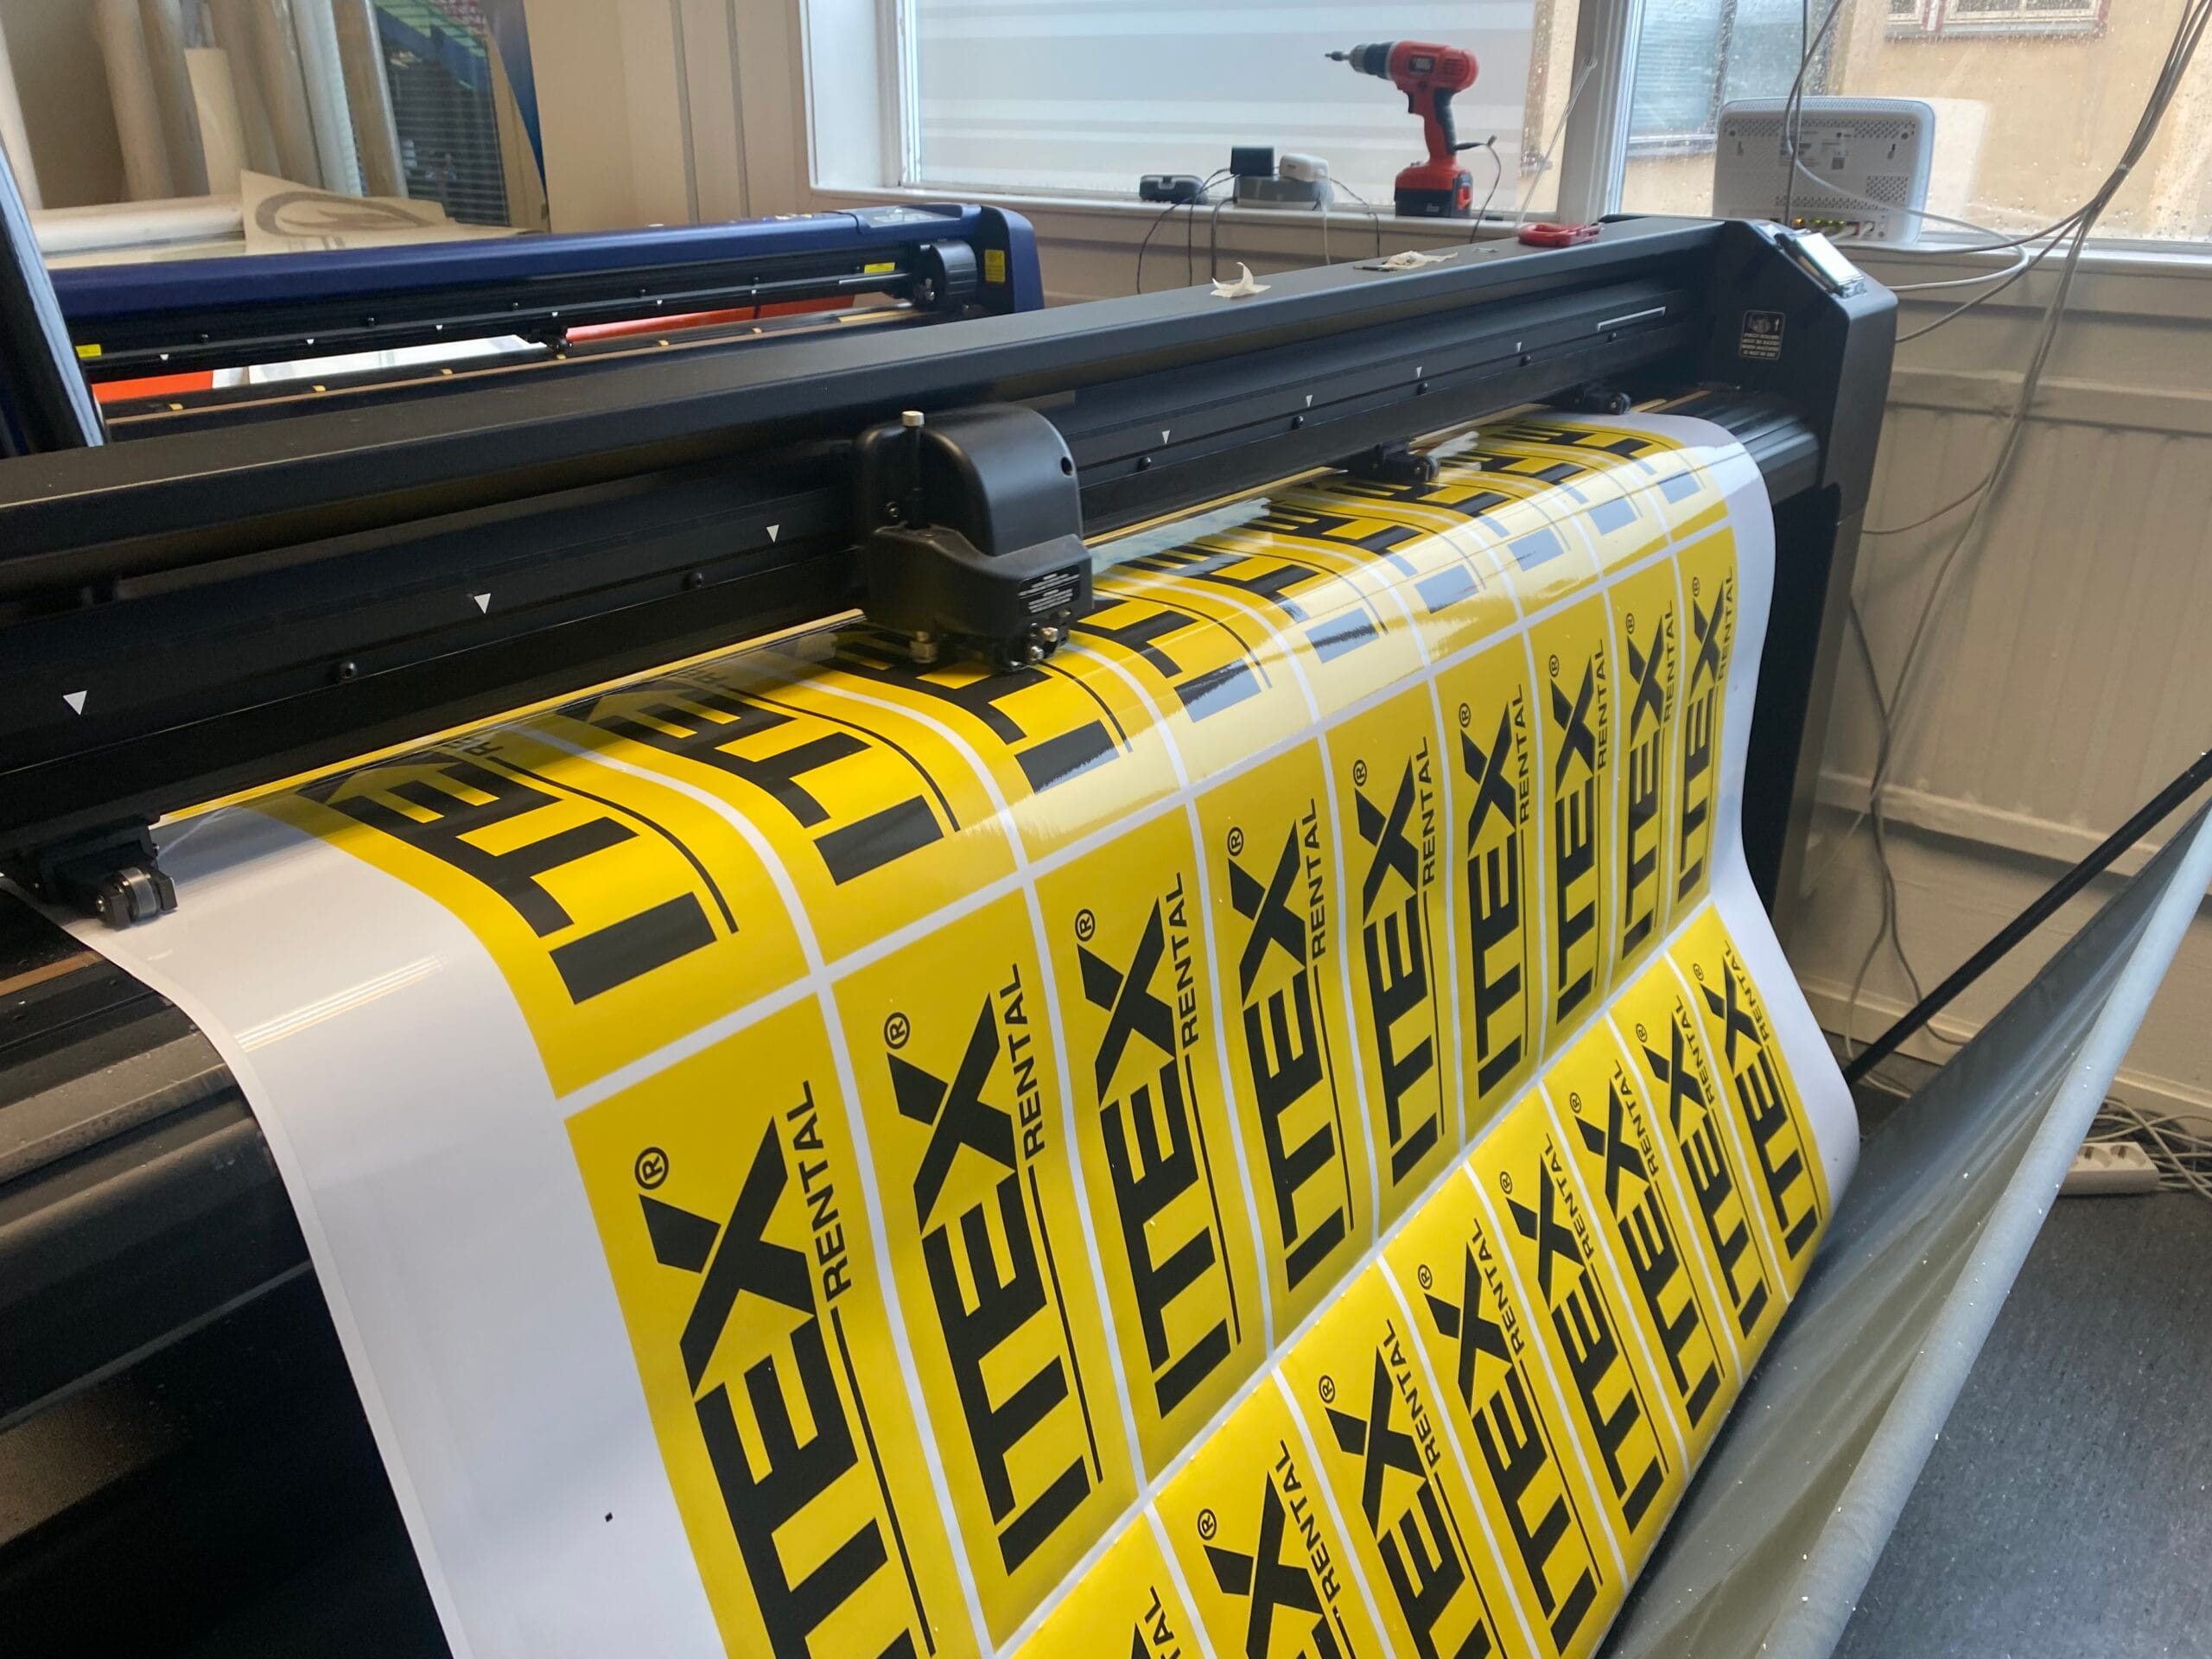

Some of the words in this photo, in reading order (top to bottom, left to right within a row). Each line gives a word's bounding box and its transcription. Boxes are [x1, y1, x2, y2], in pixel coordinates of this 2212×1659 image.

[1663, 600, 1675, 722] RENTAL
[1717, 566, 1733, 682] RENTAL
[1511, 683, 1531, 824] RENTAL
[1597, 639, 1608, 769] RENTAL
[1301, 798, 1326, 961] RENTAL
[1415, 736, 1436, 887] RENTAL
[1166, 872, 1199, 1050] RENTAL
[1724, 939, 1770, 1042] RENTAL
[999, 963, 1046, 1160] RENTAL
[1612, 1058, 1659, 1177] RENTAL
[1675, 995, 1716, 1105] RENTAL
[786, 1080, 852, 1302] RENTAL
[1546, 1132, 1595, 1261] RENTAL
[1472, 1217, 1525, 1356] RENTAL
[1383, 1318, 1442, 1469] RENTAL
[1275, 1440, 1344, 1605] RENTAL
